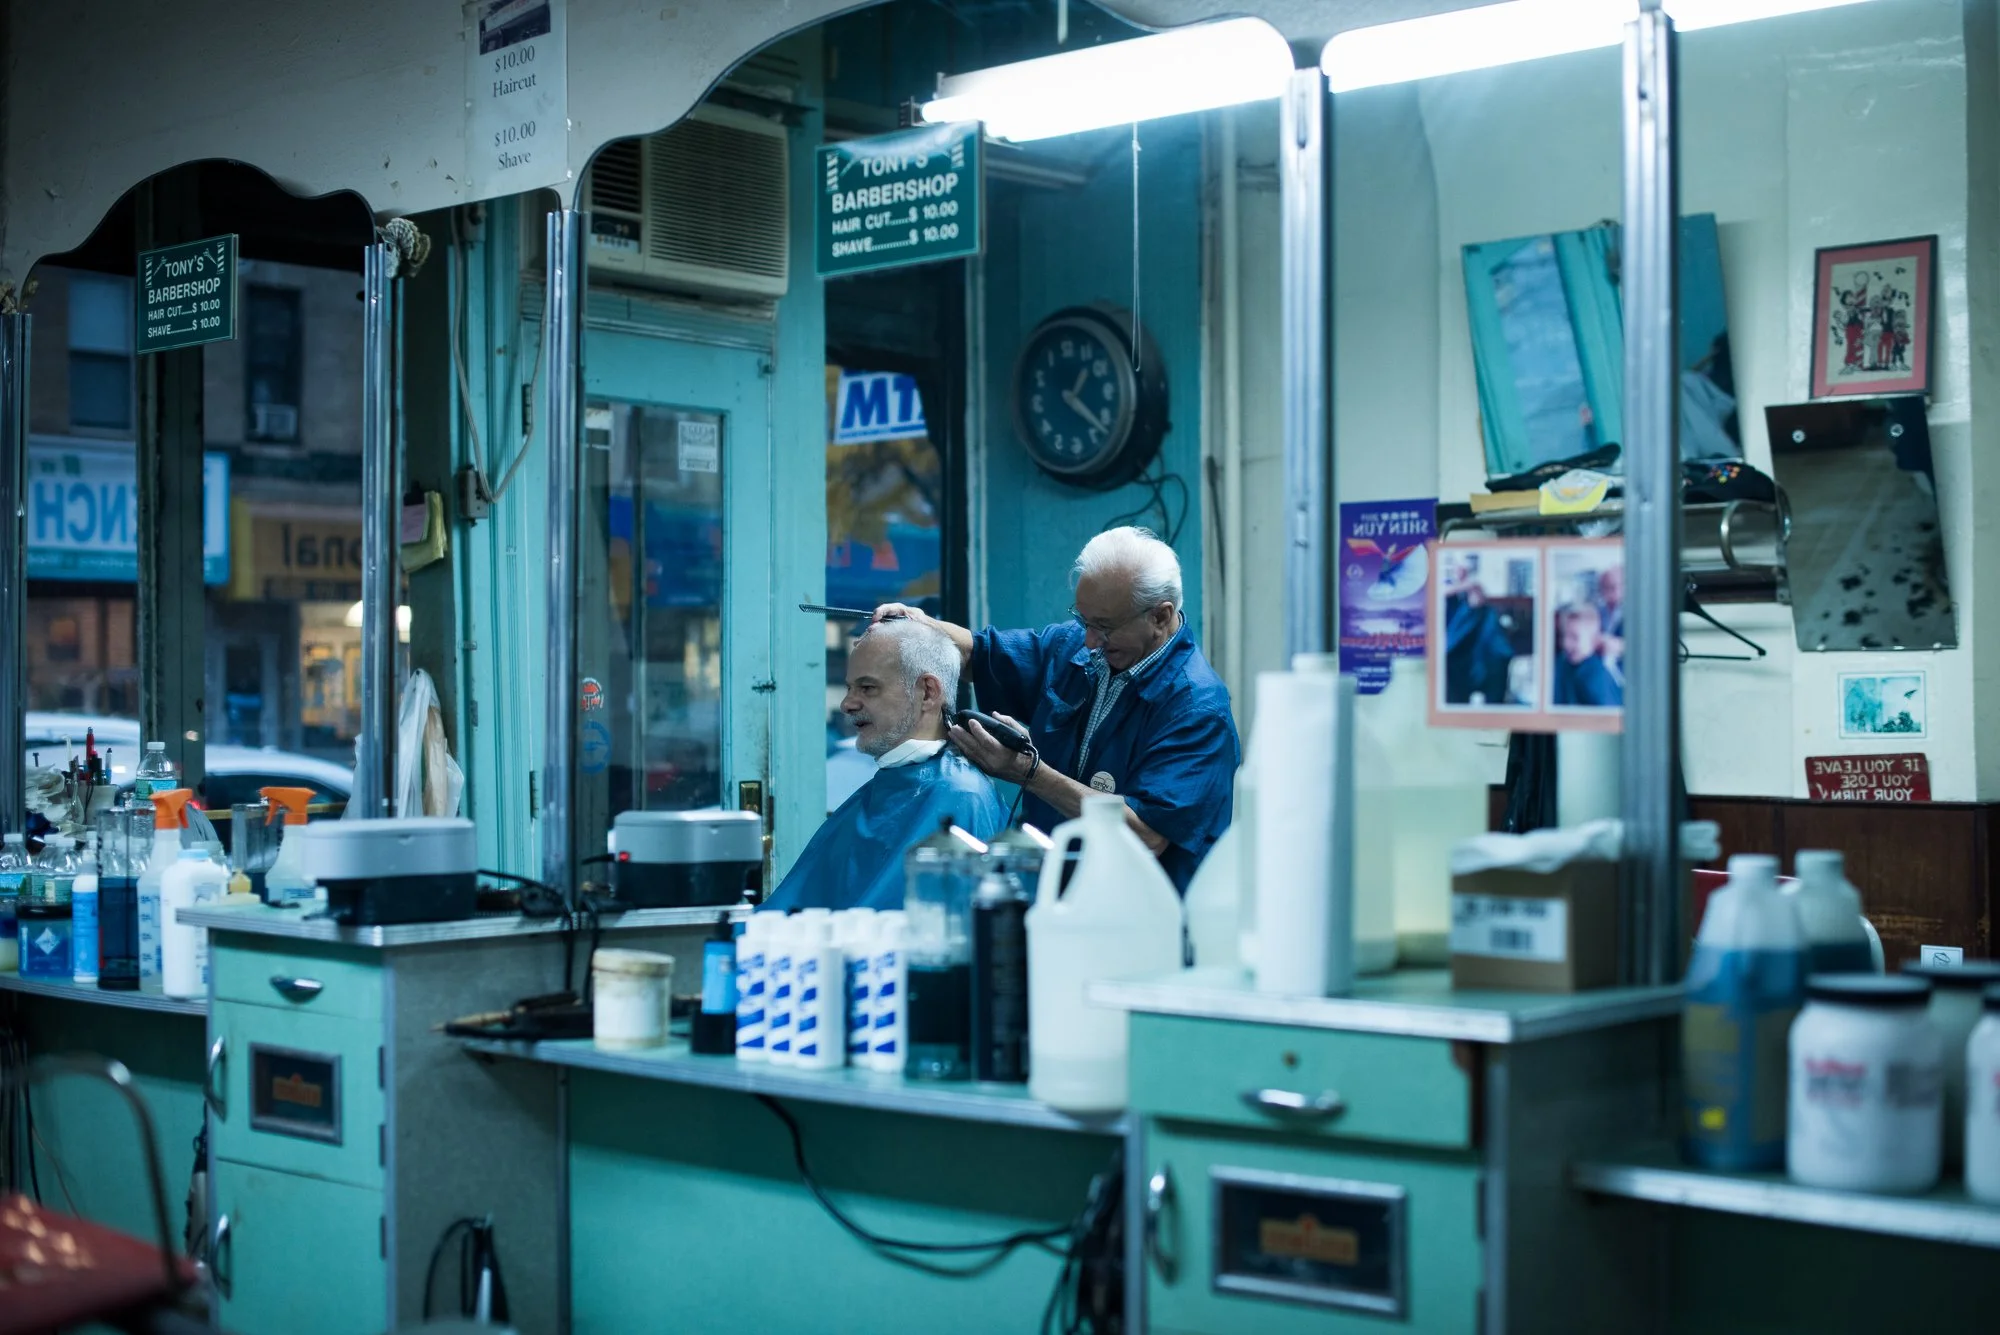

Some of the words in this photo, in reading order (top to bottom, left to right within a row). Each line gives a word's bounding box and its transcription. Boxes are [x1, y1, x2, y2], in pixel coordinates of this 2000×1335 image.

[494, 45, 535, 73] $10.00
[492, 73, 537, 98] Haircut
[494, 121, 536, 147] $10.00
[498, 152, 531, 171] Shave
[832, 172, 959, 214] BARBERSHOP
[832, 216, 861, 235] HAIR
[922, 200, 959, 220] 10.00
[922, 223, 959, 242] 10.00
[165, 255, 204, 278] TONY'S
[148, 277, 221, 304] BARBERSHOP
[148, 308, 165, 321] HAIR
[200, 298, 220, 312] 10.00
[200, 316, 220, 329] 10.00
